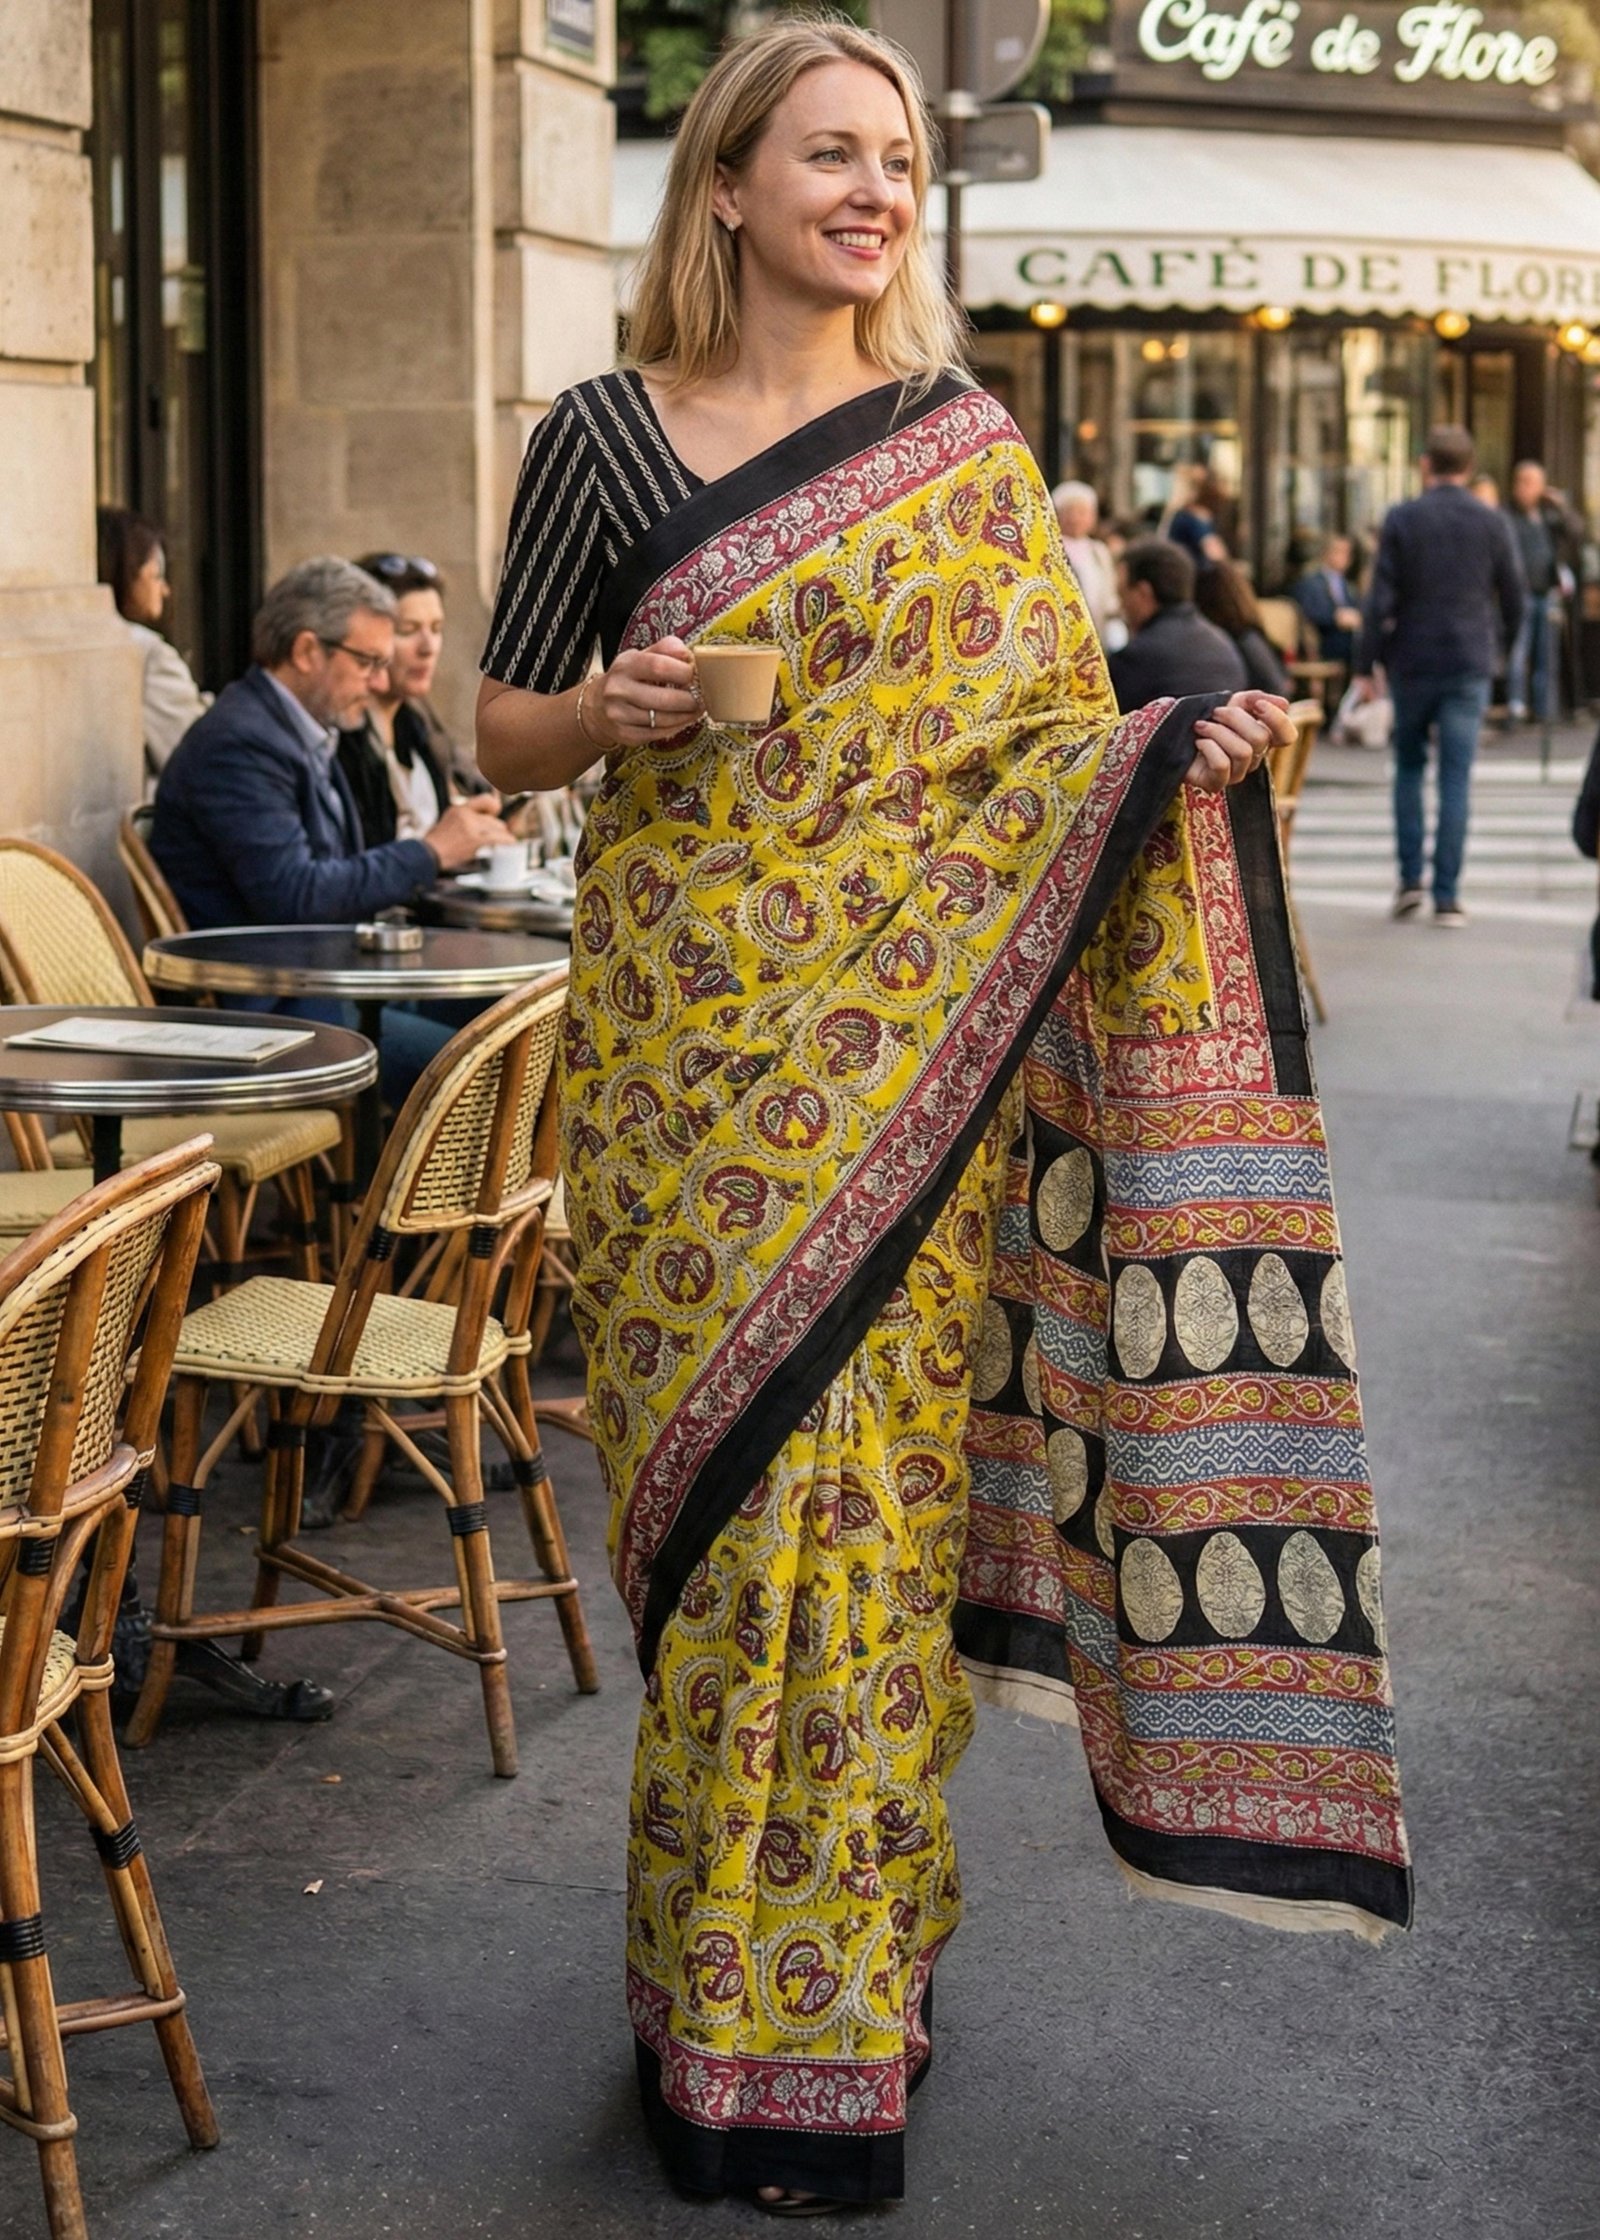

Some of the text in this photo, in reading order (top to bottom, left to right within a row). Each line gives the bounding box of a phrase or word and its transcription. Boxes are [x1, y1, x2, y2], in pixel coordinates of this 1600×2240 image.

[1138, 0, 1558, 85] Café de Flore
[1303, 253, 1400, 293] DE
